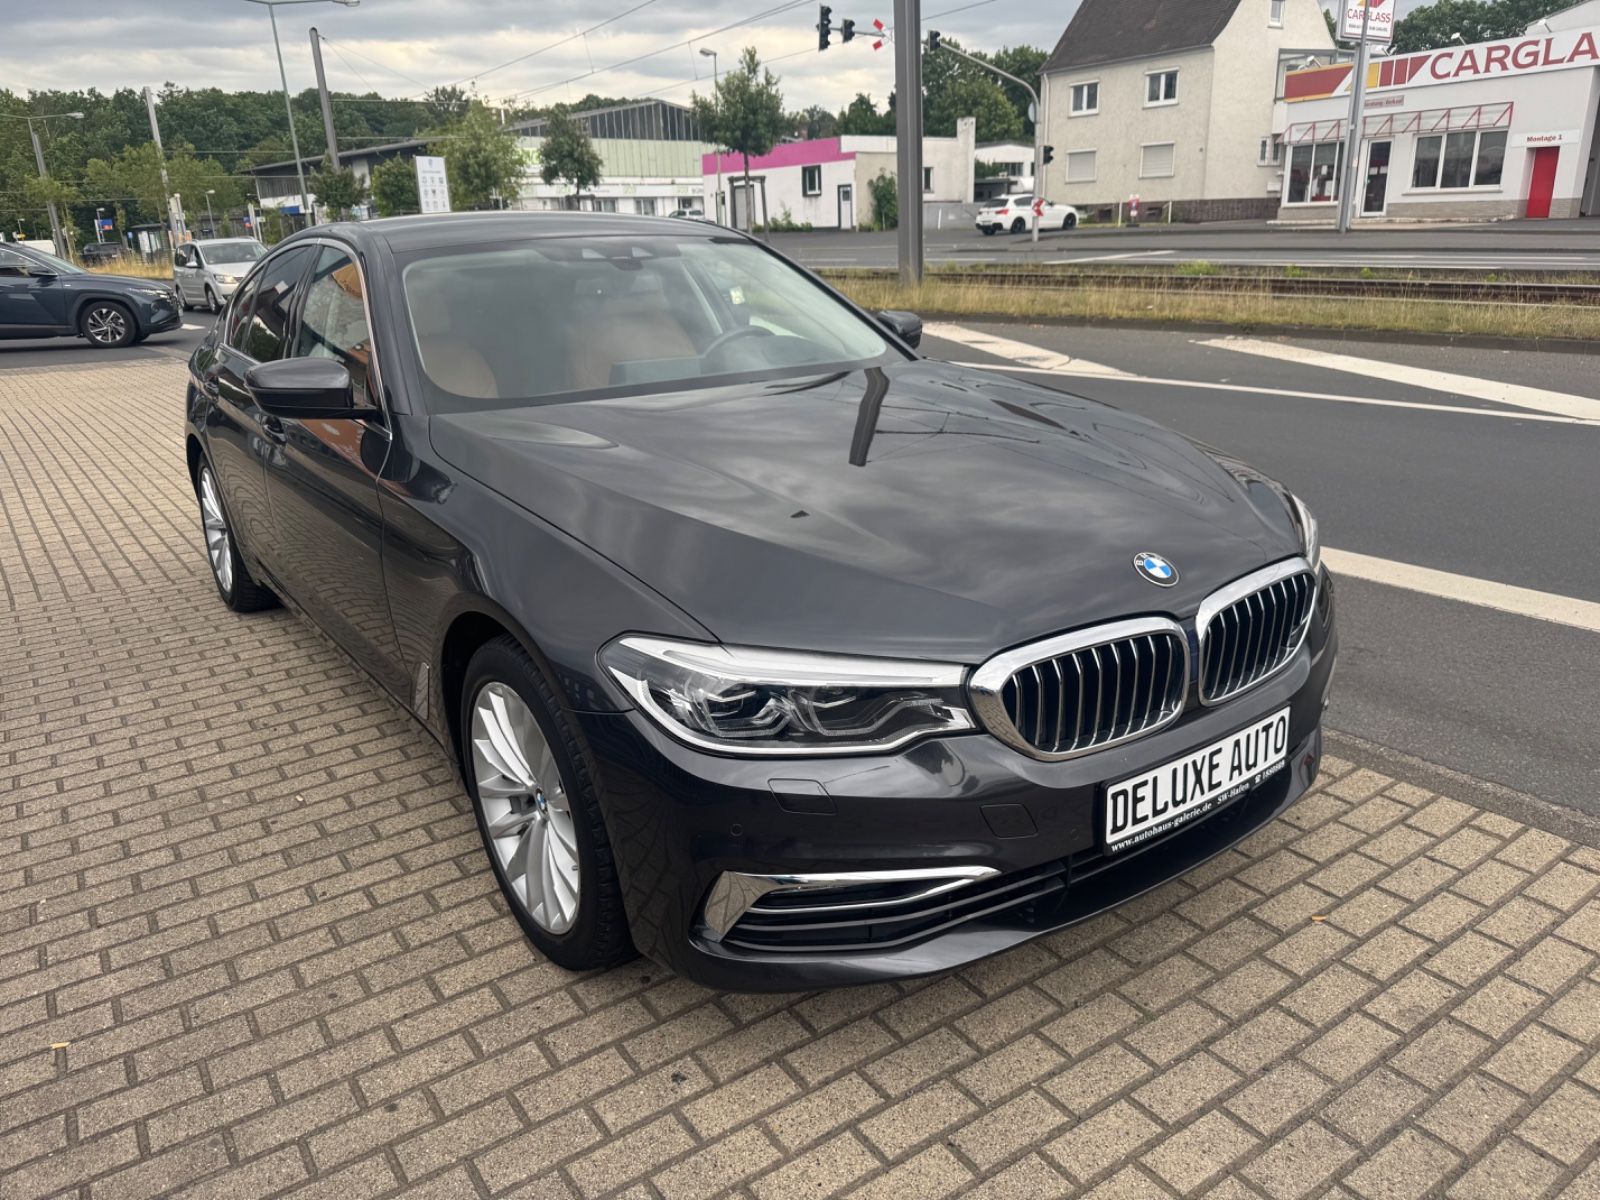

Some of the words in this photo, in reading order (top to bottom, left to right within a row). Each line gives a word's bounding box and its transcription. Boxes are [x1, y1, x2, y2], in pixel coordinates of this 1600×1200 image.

[1347, 9, 1391, 23] CARLASS
[1430, 32, 1600, 80] CARGLA
[1109, 747, 1223, 835] DELUXE
[1229, 715, 1287, 781] AUTO
[1111, 802, 1212, 852] www.autohaus-galerie.de
